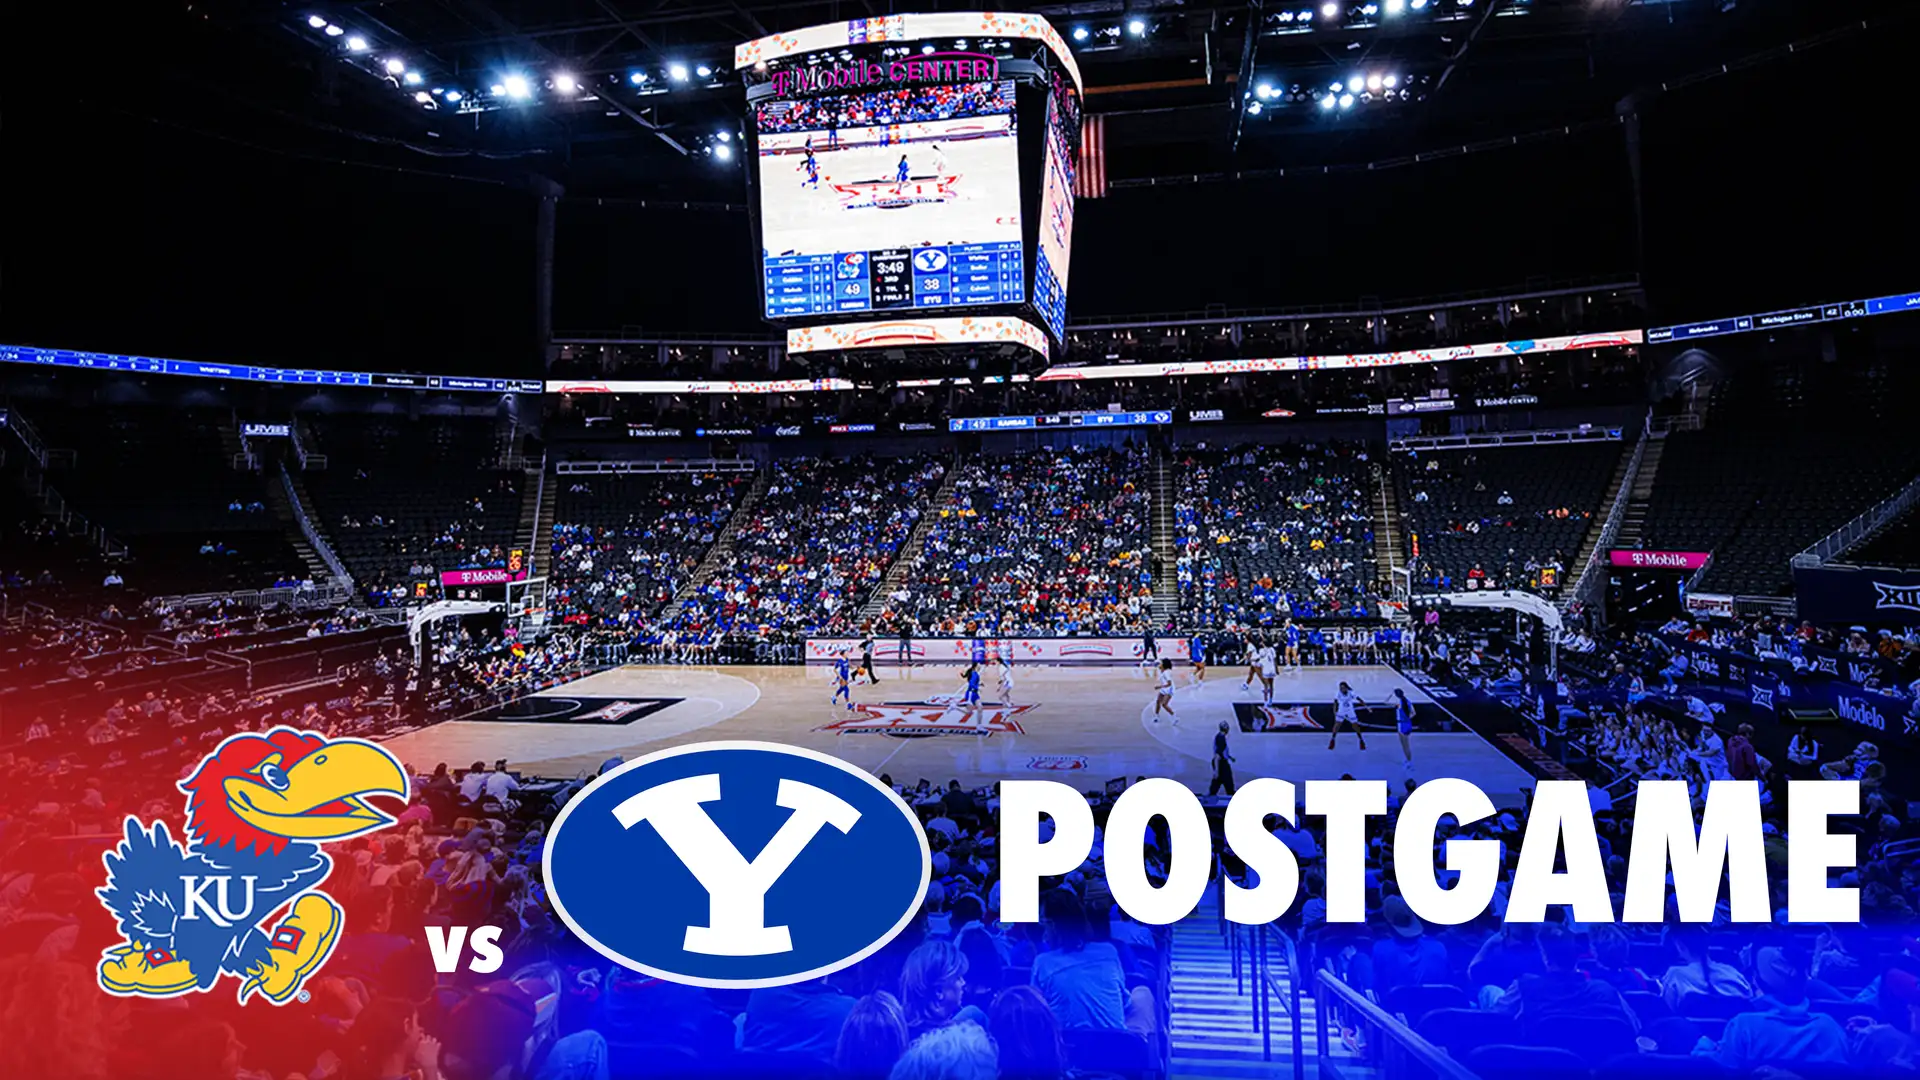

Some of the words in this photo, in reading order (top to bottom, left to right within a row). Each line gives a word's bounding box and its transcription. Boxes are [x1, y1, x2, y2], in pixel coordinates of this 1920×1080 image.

[796, 56, 882, 93] Mobile
[890, 59, 990, 82] CENTER
[844, 283, 860, 295] 49
[924, 278, 940, 290] 38
[924, 296, 942, 304] BYU
[1761, 315, 1792, 325] Michigan
[1794, 313, 1813, 321] State
[1645, 552, 1687, 567] Mobile
[472, 570, 508, 583] Mobile
[1838, 695, 1885, 731] Modelo
